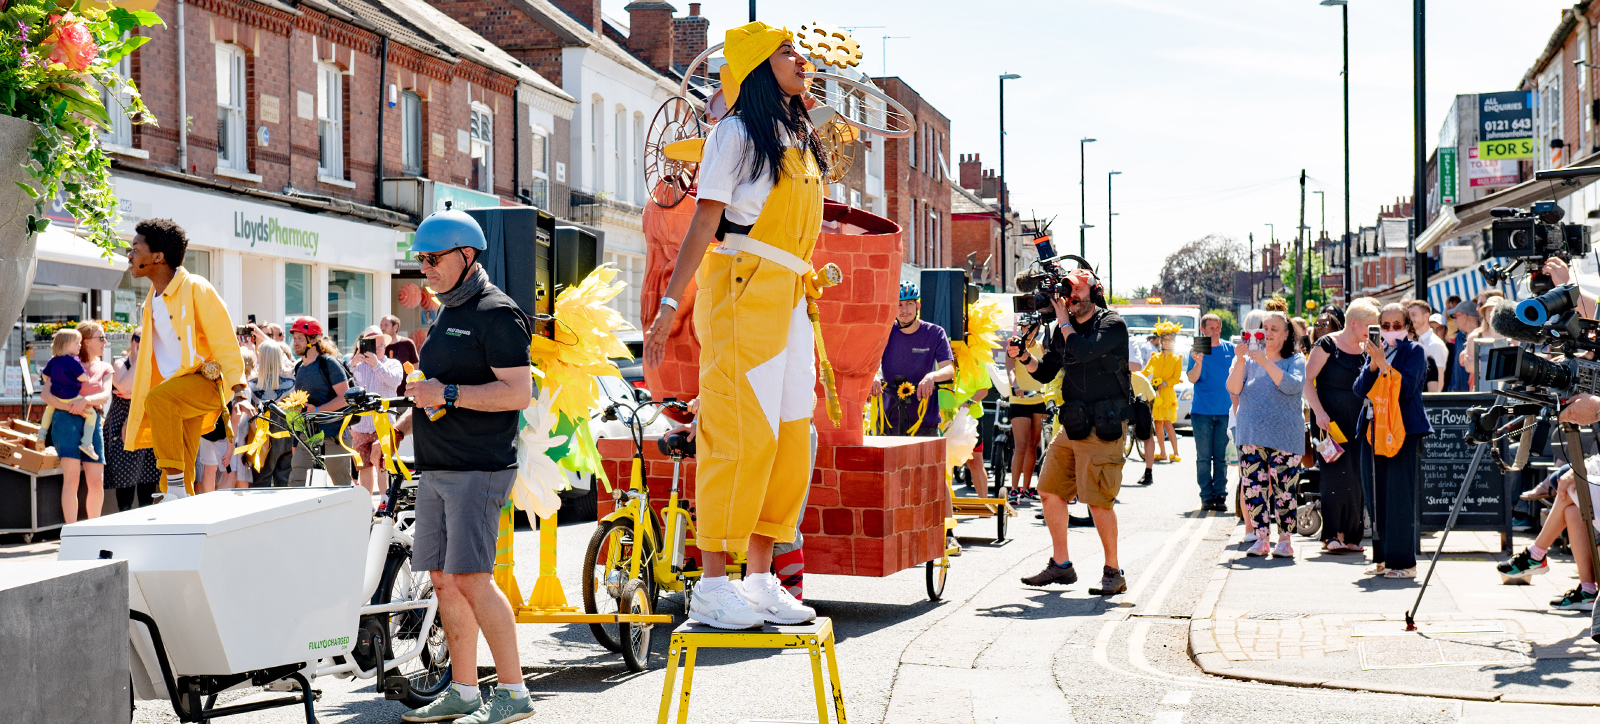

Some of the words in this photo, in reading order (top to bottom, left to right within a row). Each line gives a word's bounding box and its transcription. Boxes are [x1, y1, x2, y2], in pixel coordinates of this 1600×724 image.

[1484, 97, 1498, 105] ALL
[1483, 102, 1523, 113] ENQUIRIES
[1484, 120, 1509, 131] 0121
[1511, 118, 1532, 130] 643
[1486, 142, 1517, 156] FOR
[1470, 161, 1482, 169] TO
[120, 199, 132, 212] NHS
[234, 210, 319, 257] LloydsPharmacy
[1426, 449, 1458, 460] Saturdays
[1424, 471, 1447, 480] tables
[1423, 481, 1435, 489] for
[1475, 481, 1489, 489] food
[308, 640, 323, 650] FULLY
[327, 636, 350, 648] CHARGED
